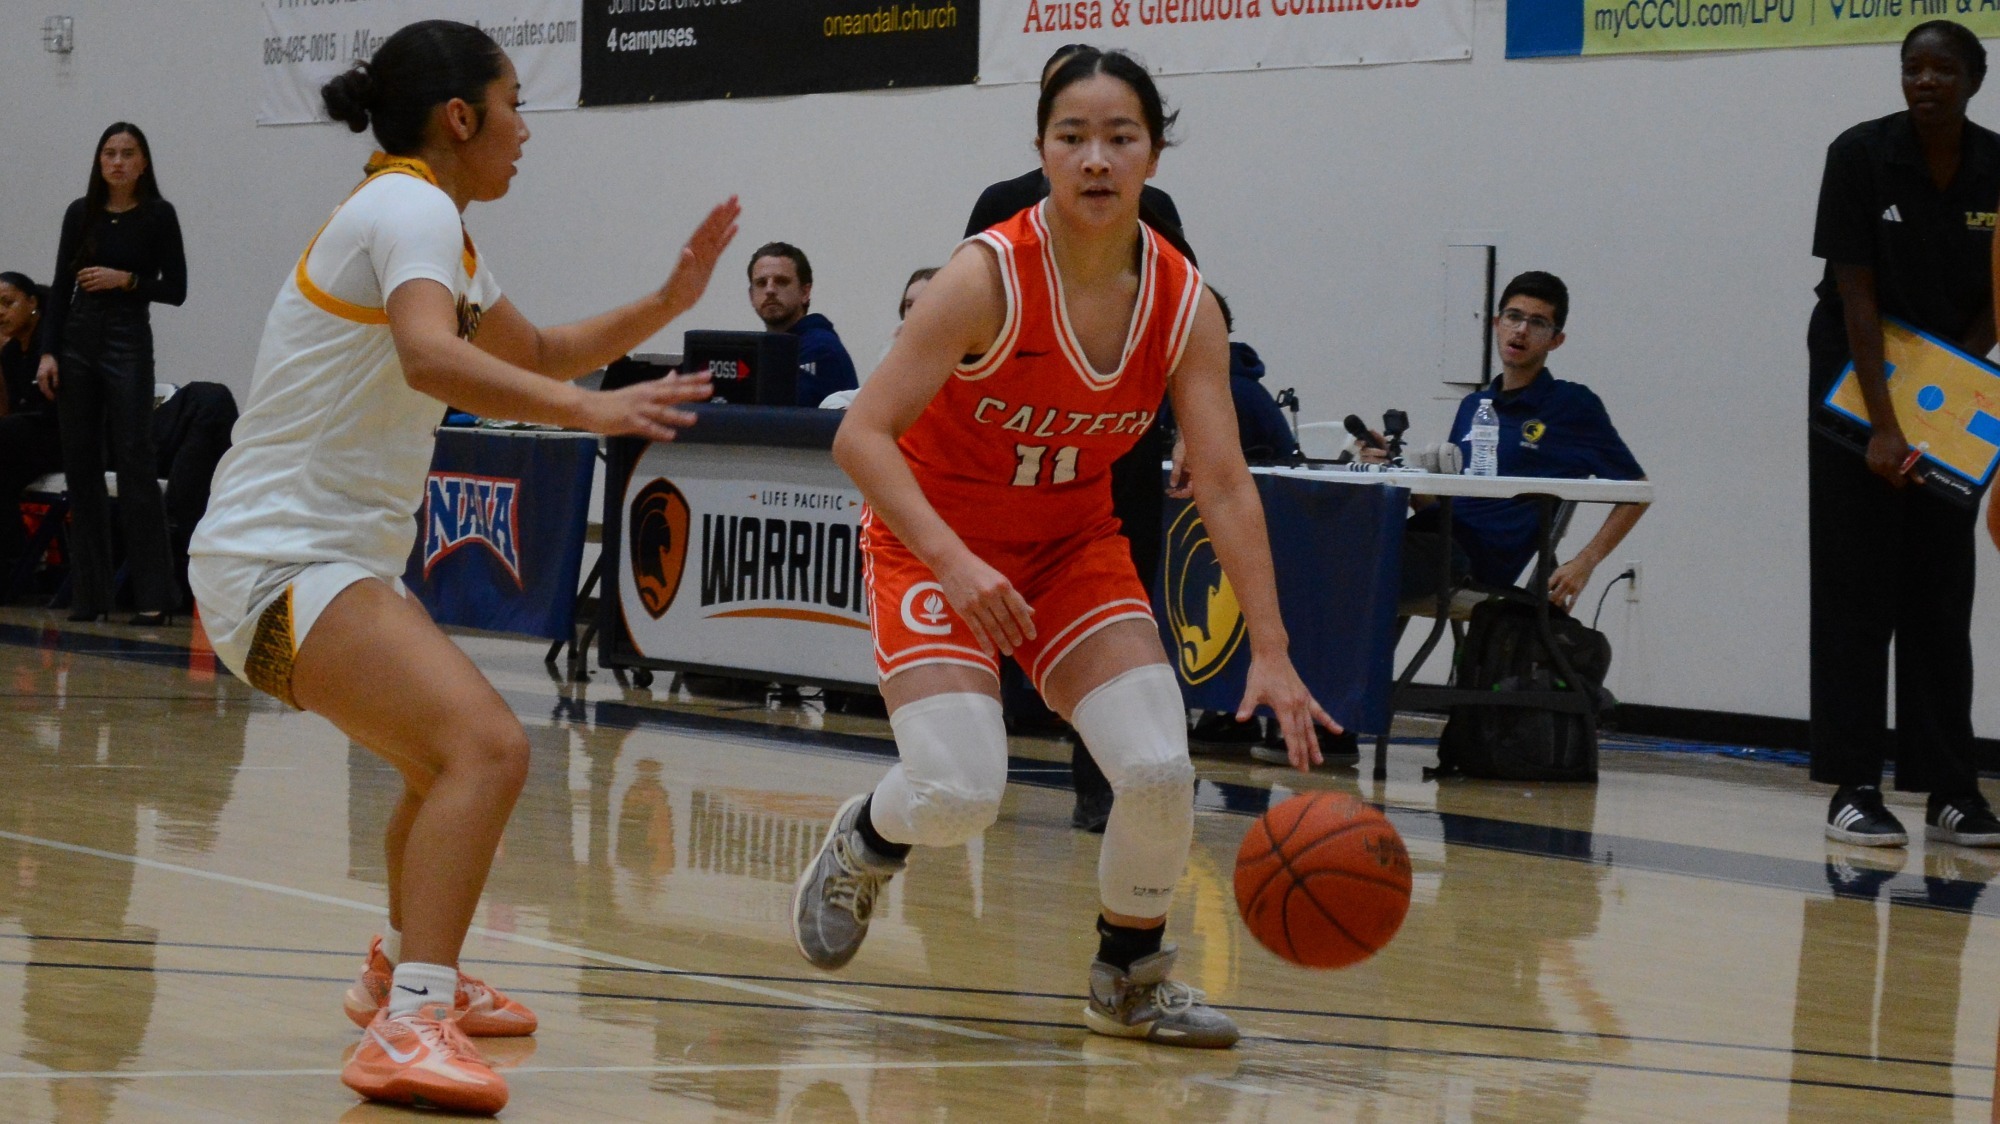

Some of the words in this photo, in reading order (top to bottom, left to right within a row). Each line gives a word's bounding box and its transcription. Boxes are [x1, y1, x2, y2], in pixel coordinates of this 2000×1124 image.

[823, 0, 957, 36] oneandall.church
[1023, 0, 1101, 33] Azusa
[1111, 0, 1130, 28] &
[1139, 0, 1261, 25] Glendora
[1594, 0, 1795, 38] myCCCU.com/LPU
[263, 32, 336, 65] 866-485-0015
[607, 27, 618, 52] 4
[620, 26, 697, 55] campuses.
[709, 360, 738, 379] POSS
[974, 397, 1157, 437] CALTECH
[1012, 443, 1080, 487] 11
[762, 490, 788, 506] LIFE
[794, 493, 843, 510] PACIFIC
